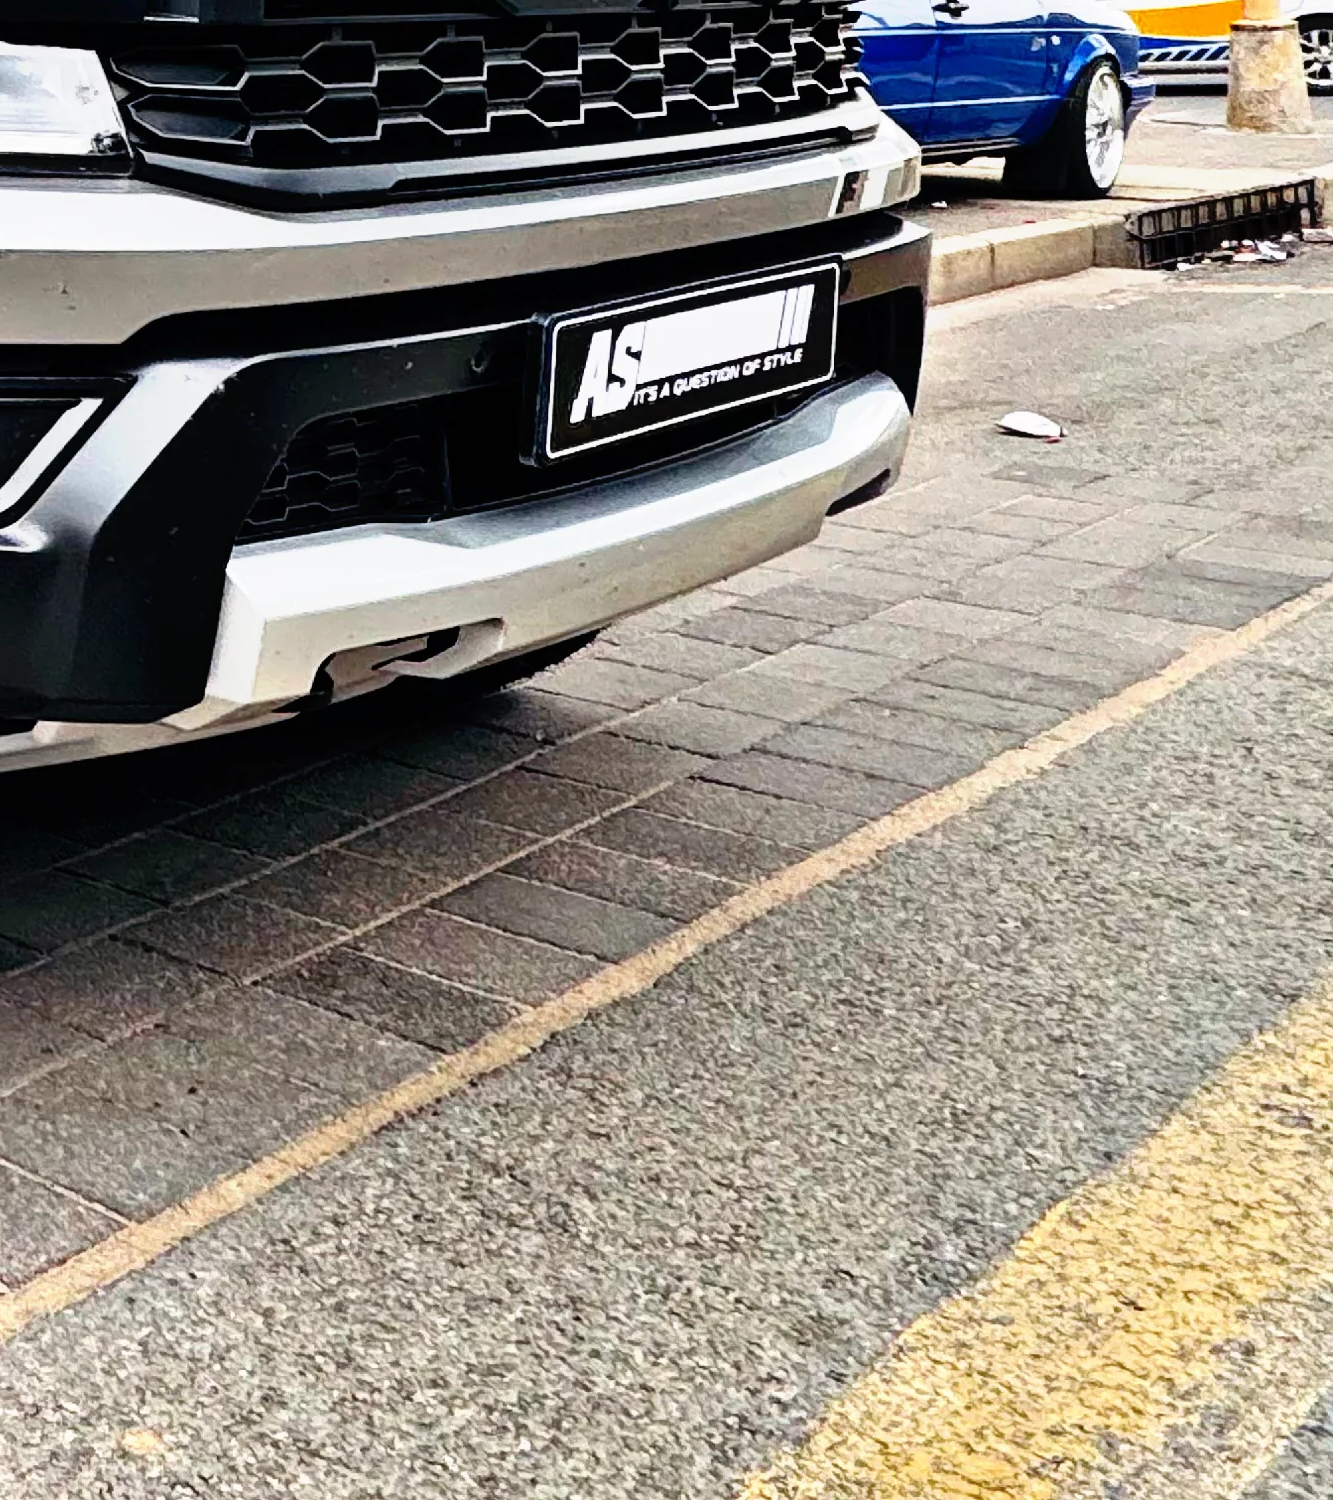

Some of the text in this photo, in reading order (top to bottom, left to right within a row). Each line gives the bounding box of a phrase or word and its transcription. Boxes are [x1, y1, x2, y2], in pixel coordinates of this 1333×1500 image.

[659, 382, 670, 398] A
[673, 364, 740, 396] QUESTION
[742, 358, 761, 376] OF
[763, 348, 803, 371] STYLE
